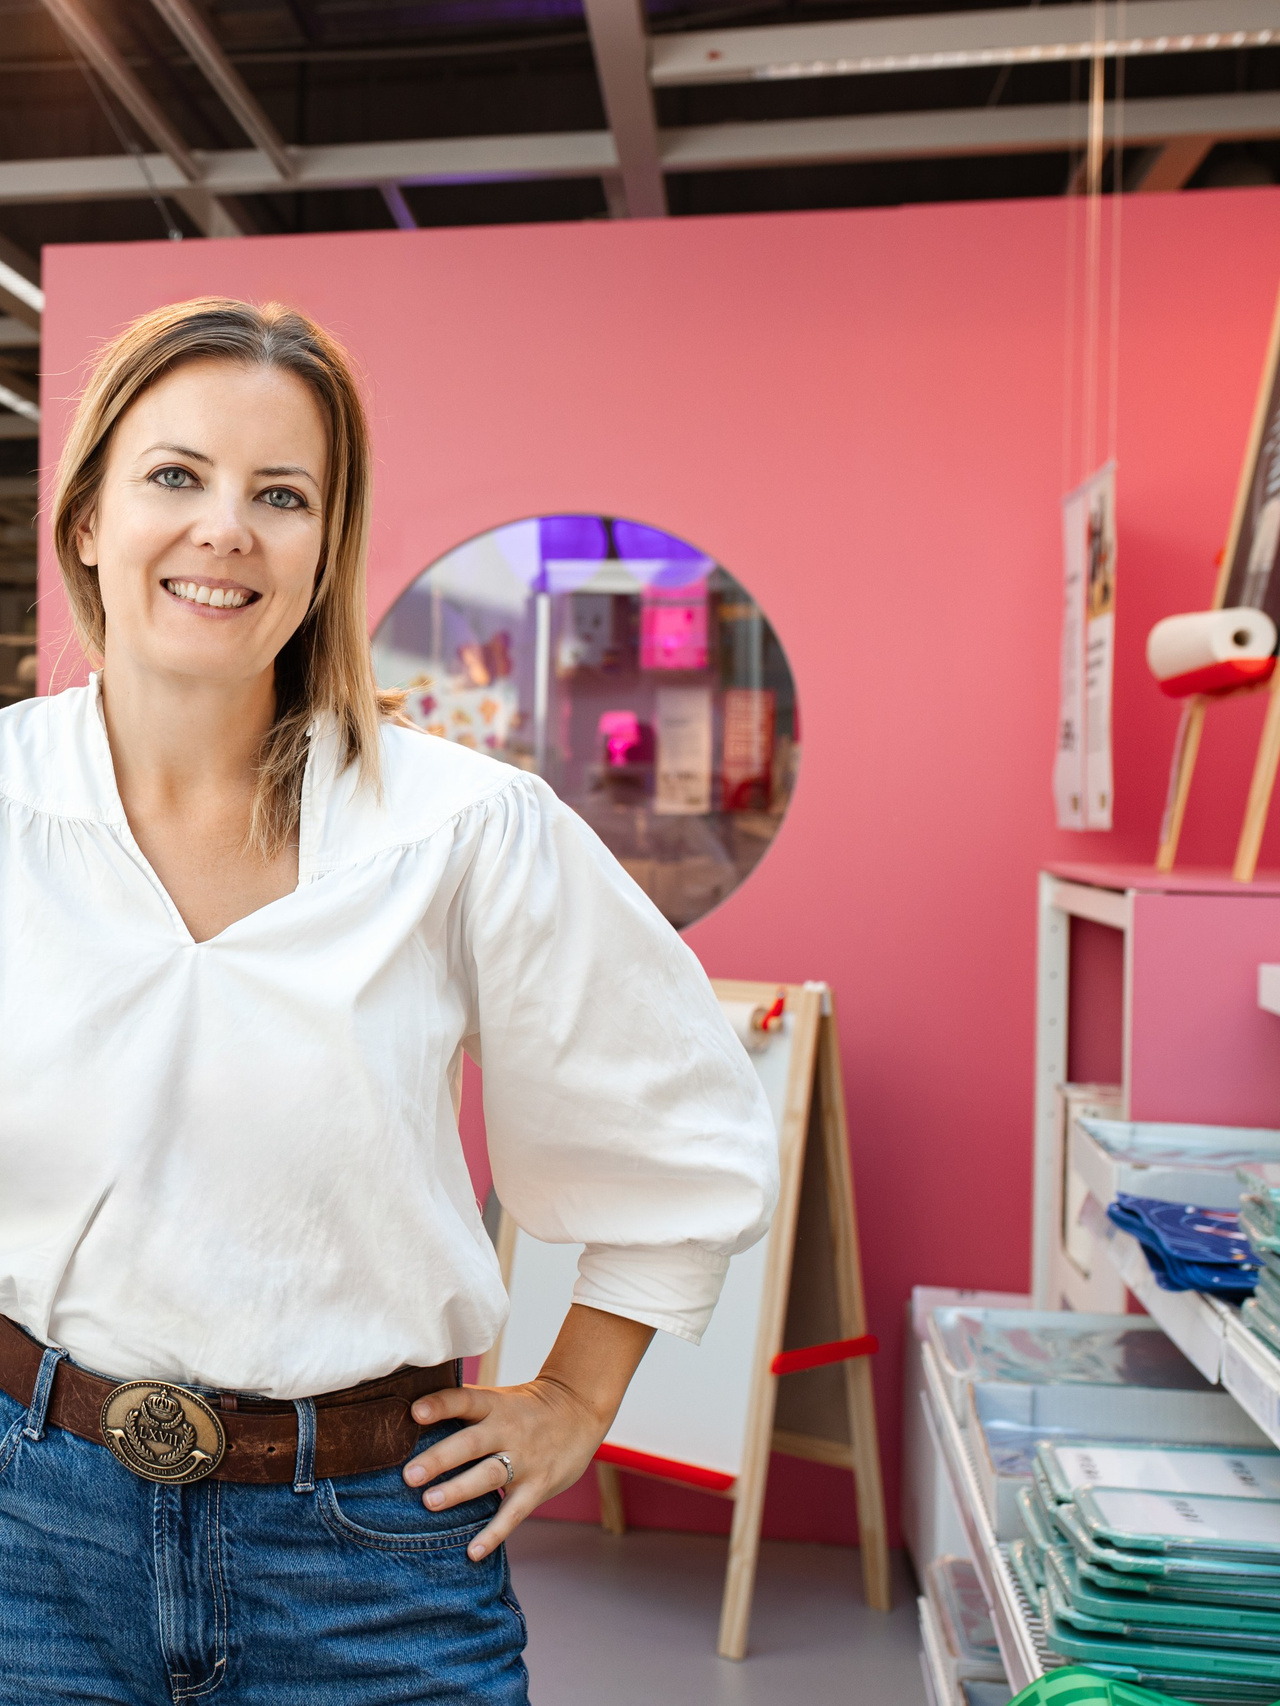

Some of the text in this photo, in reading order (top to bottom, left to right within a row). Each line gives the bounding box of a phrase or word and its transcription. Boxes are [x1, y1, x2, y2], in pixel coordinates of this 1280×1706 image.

[139, 1426, 178, 1446] LXVII
[144, 1464, 167, 1475] RALPH
[169, 1458, 194, 1475] LAUREN
